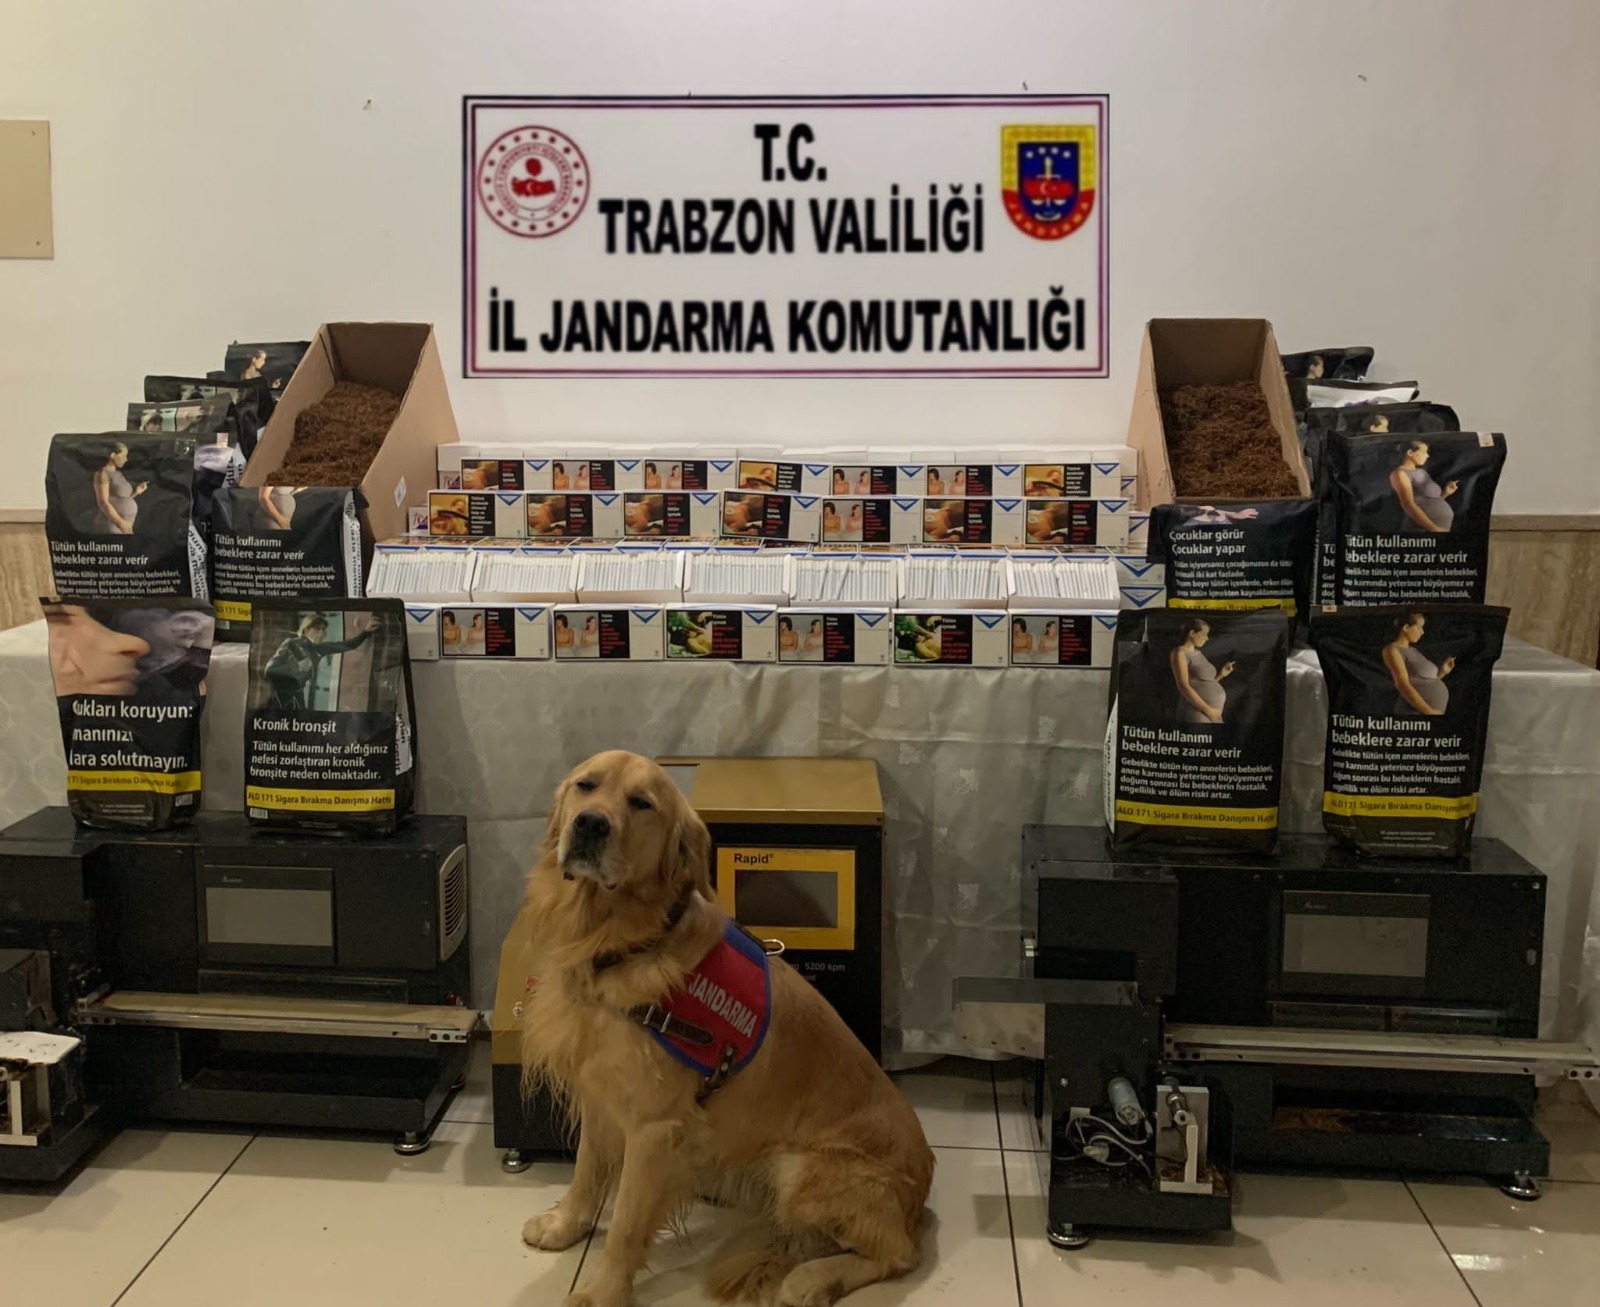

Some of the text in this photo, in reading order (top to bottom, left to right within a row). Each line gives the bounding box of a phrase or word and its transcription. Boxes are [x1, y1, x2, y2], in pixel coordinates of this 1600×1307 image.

[754, 124, 828, 182] T.C.
[598, 184, 985, 254] TRABZON VALİLİĞİ
[488, 286, 1085, 353] İL JANDARMA KOMUTANLIĞI
[236, 536, 282, 547] kullanımı
[1169, 530, 1244, 542] Çocuklar görür
[1376, 535, 1436, 548] kullanımı
[78, 541, 124, 552] kullanımı
[1172, 544, 1246, 556] Çocuklar yapar
[98, 556, 122, 564] zarar
[125, 555, 148, 565] verir
[256, 550, 280, 559] zarar
[284, 550, 305, 560] verir
[1404, 554, 1436, 563] zarar
[1438, 551, 1468, 563] verir
[120, 700, 193, 723] koruyun:
[254, 718, 337, 736] Kronik bronşit
[1332, 714, 1431, 732] Tütün kullanımı
[1122, 725, 1212, 744] Tütün kullanımı
[1332, 730, 1462, 748] bebeklere zarar verir
[252, 740, 388, 756] Tütün kullanımı her aldığınız
[1122, 740, 1242, 758] bebeklere zarar verir
[100, 750, 188, 773] solutmayın.
[252, 754, 365, 770] nefesi zorlaştıran kronik
[1362, 751, 1384, 760] tütün
[1385, 752, 1400, 761] içen
[1121, 757, 1158, 768] Gebelikte
[1160, 762, 1180, 770] tütün
[1182, 762, 1198, 772] içen
[1199, 764, 1236, 772] annelerin
[1346, 761, 1379, 770] karnında
[1380, 762, 1414, 772] yeterince
[250, 766, 382, 781] bronşite neden olmaktadır.
[1142, 768, 1178, 778] karnında
[1179, 772, 1216, 782] yeterince
[1218, 773, 1263, 784] büyüyemez
[1352, 774, 1432, 783] sonrası bu bebeklerin
[1120, 775, 1148, 786] doğum
[1150, 779, 1178, 788] sonrası
[1180, 779, 1190, 788] bu
[1192, 781, 1234, 790] bebeklerin
[1370, 785, 1390, 793] ölüm
[1391, 786, 1407, 794] riski
[261, 793, 274, 802] 171
[275, 794, 299, 805] Sigara
[300, 796, 332, 804] Bırakma
[334, 796, 370, 806] Danışma
[1158, 788, 1168, 796] ve
[1169, 788, 1190, 798] ölüm
[1191, 790, 1209, 798] riski
[1359, 802, 1386, 812] Sigara
[1388, 802, 1422, 810] Bırakma
[1136, 808, 1150, 817] 171
[1153, 810, 1180, 820] Sigara
[1182, 812, 1216, 822] Bırakma
[1219, 814, 1256, 825] Danışma
[804, 962, 826, 970] 5200
[828, 962, 846, 972] kpm
[688, 973, 758, 1038] JANDARMA
